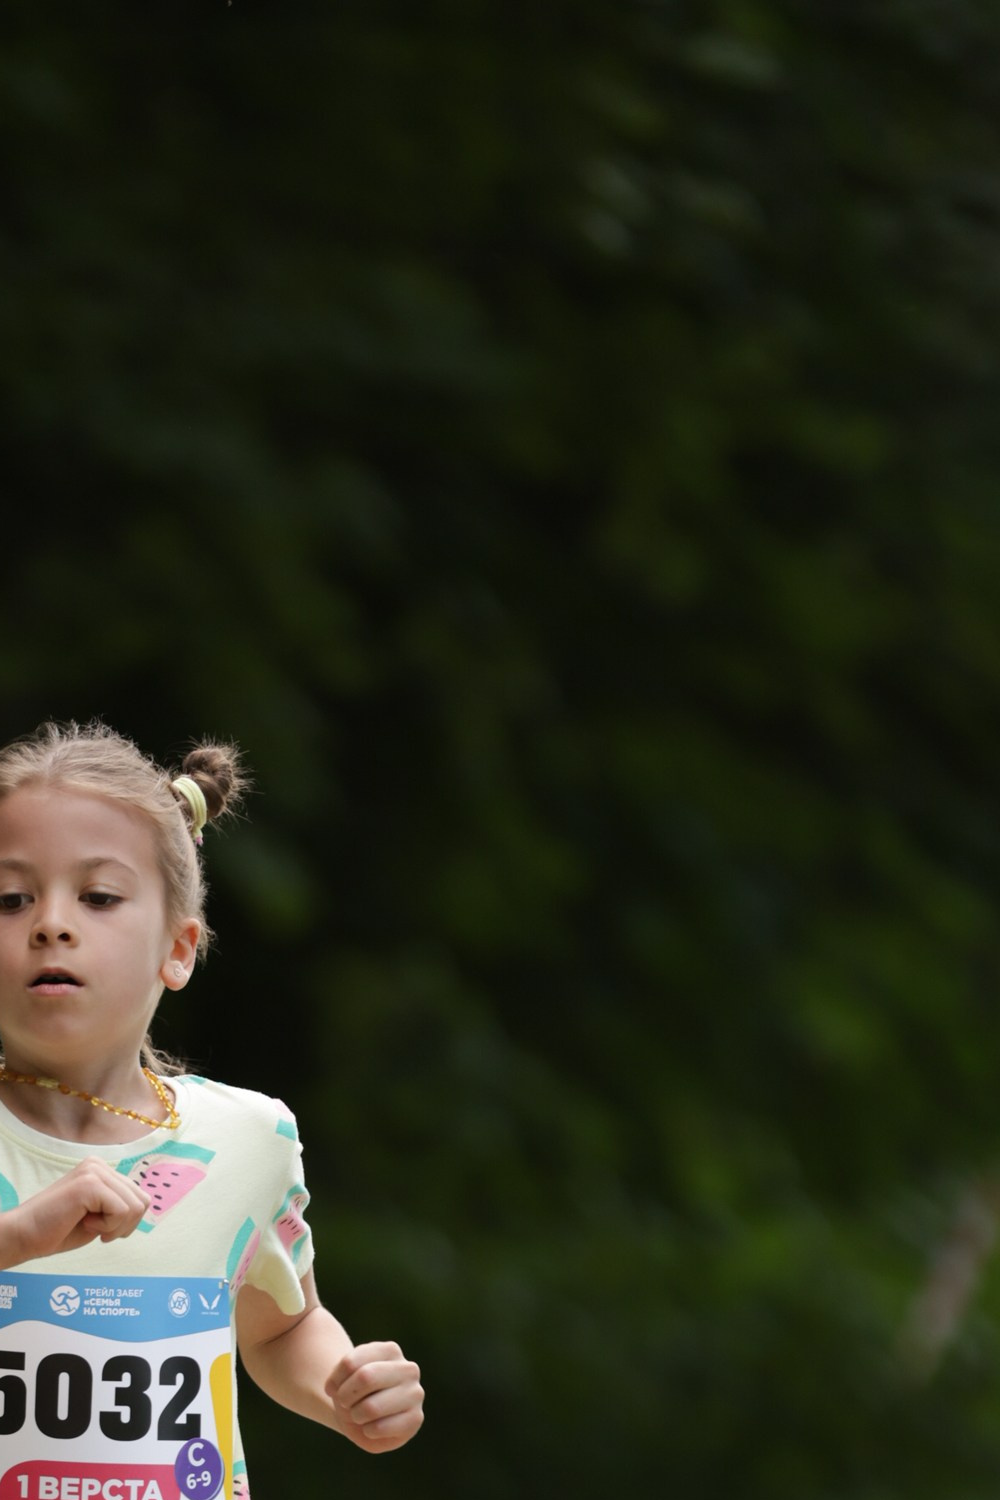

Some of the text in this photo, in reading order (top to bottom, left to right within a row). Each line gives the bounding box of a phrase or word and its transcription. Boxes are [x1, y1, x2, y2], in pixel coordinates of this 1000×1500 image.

[84, 1287, 145, 1298] ТРЕЙЛ ЗАБЕГ
[83, 1297, 121, 1307] «СЕМЬЯ
[83, 1307, 140, 1317] НА СПОРТЕ»
[17, 1474, 29, 1498] 1
[186, 1471, 212, 1490] 6-9
